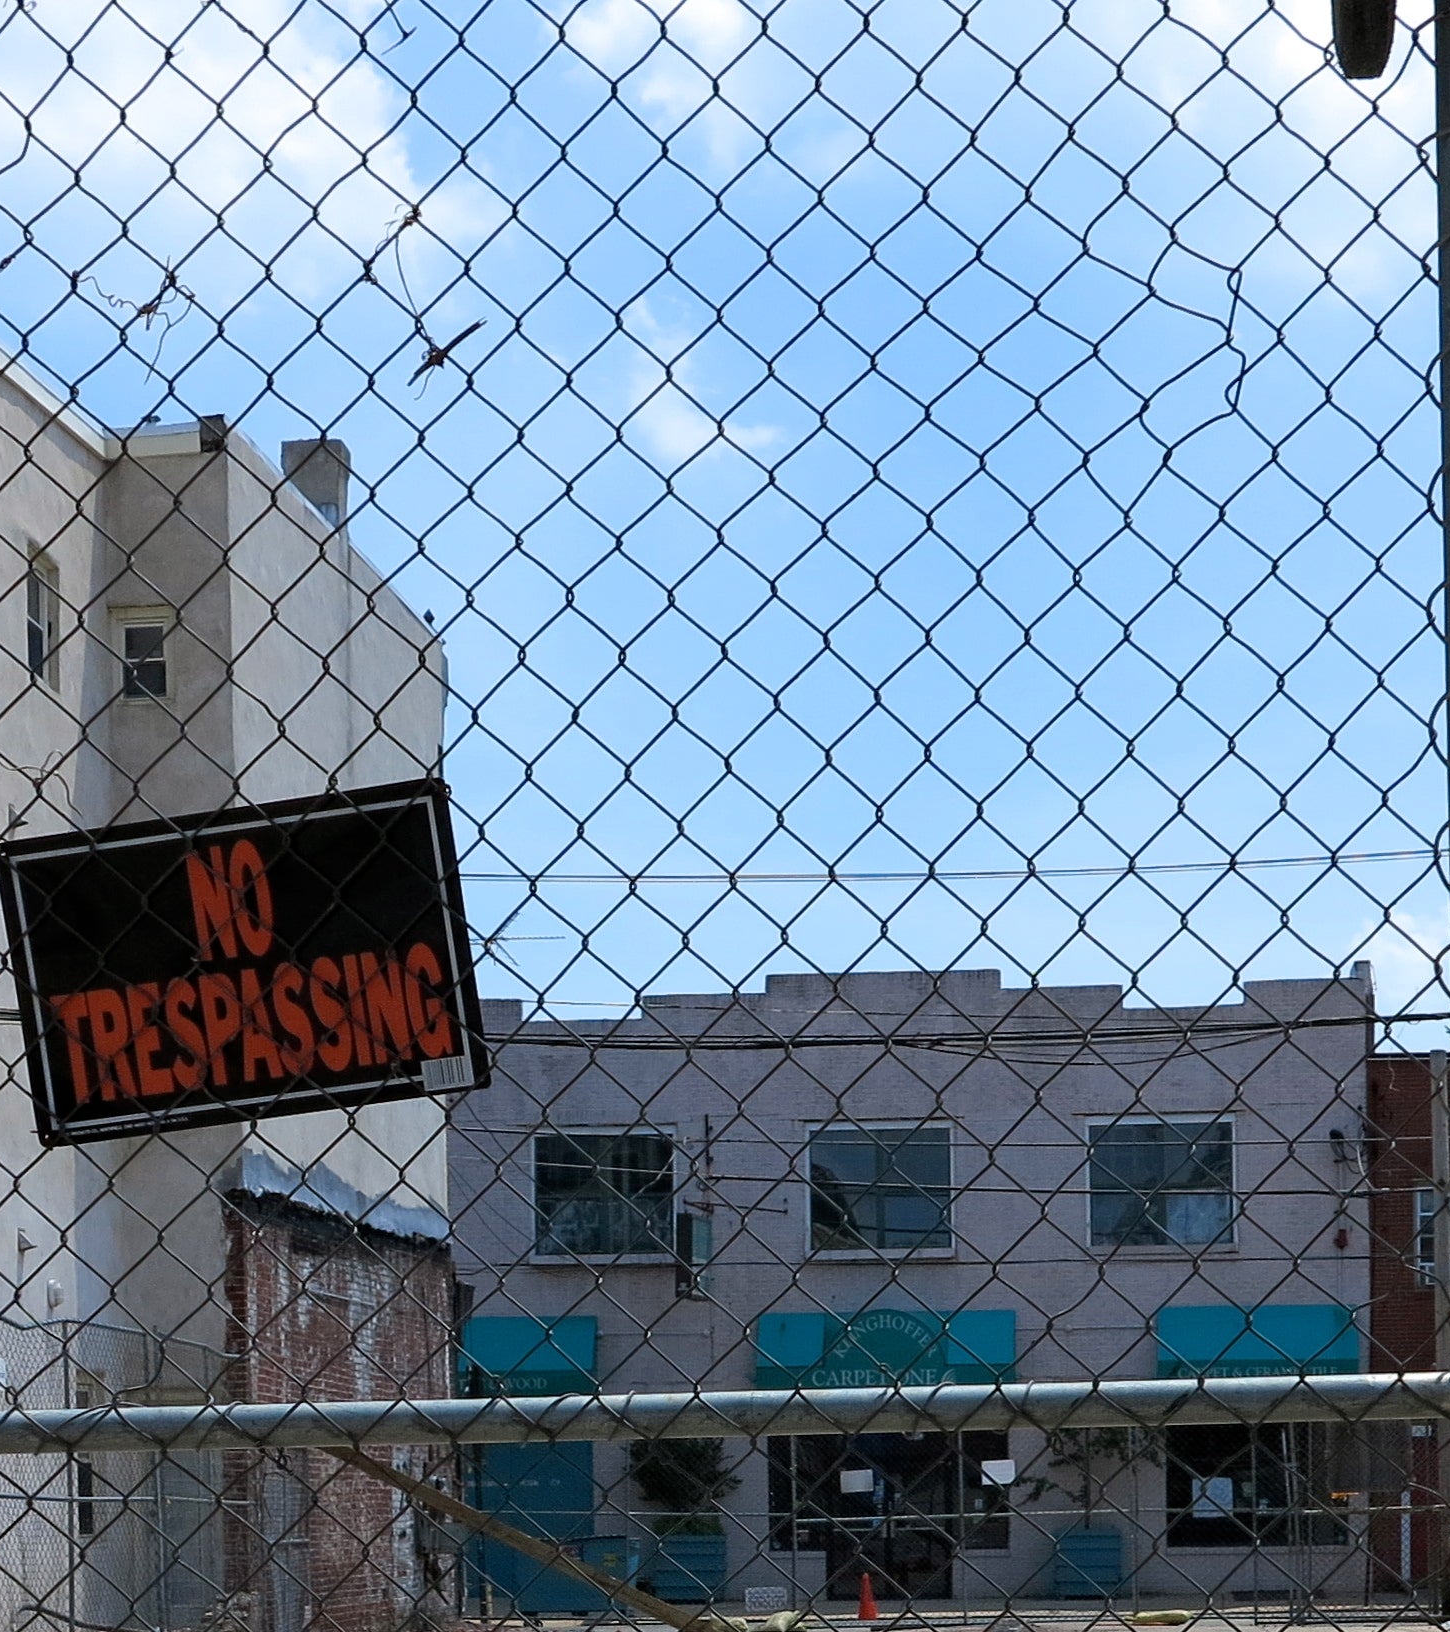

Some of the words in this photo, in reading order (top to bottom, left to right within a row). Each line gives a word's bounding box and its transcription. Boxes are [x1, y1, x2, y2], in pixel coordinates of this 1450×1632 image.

[186, 839, 274, 961] NO
[49, 942, 454, 1104] TRESPASSING
[832, 1314, 938, 1359] KLINGHOFFER
[811, 1368, 890, 1388] CARPET
[895, 1367, 938, 1386] ONE
[1246, 1366, 1306, 1376] CERAMI
